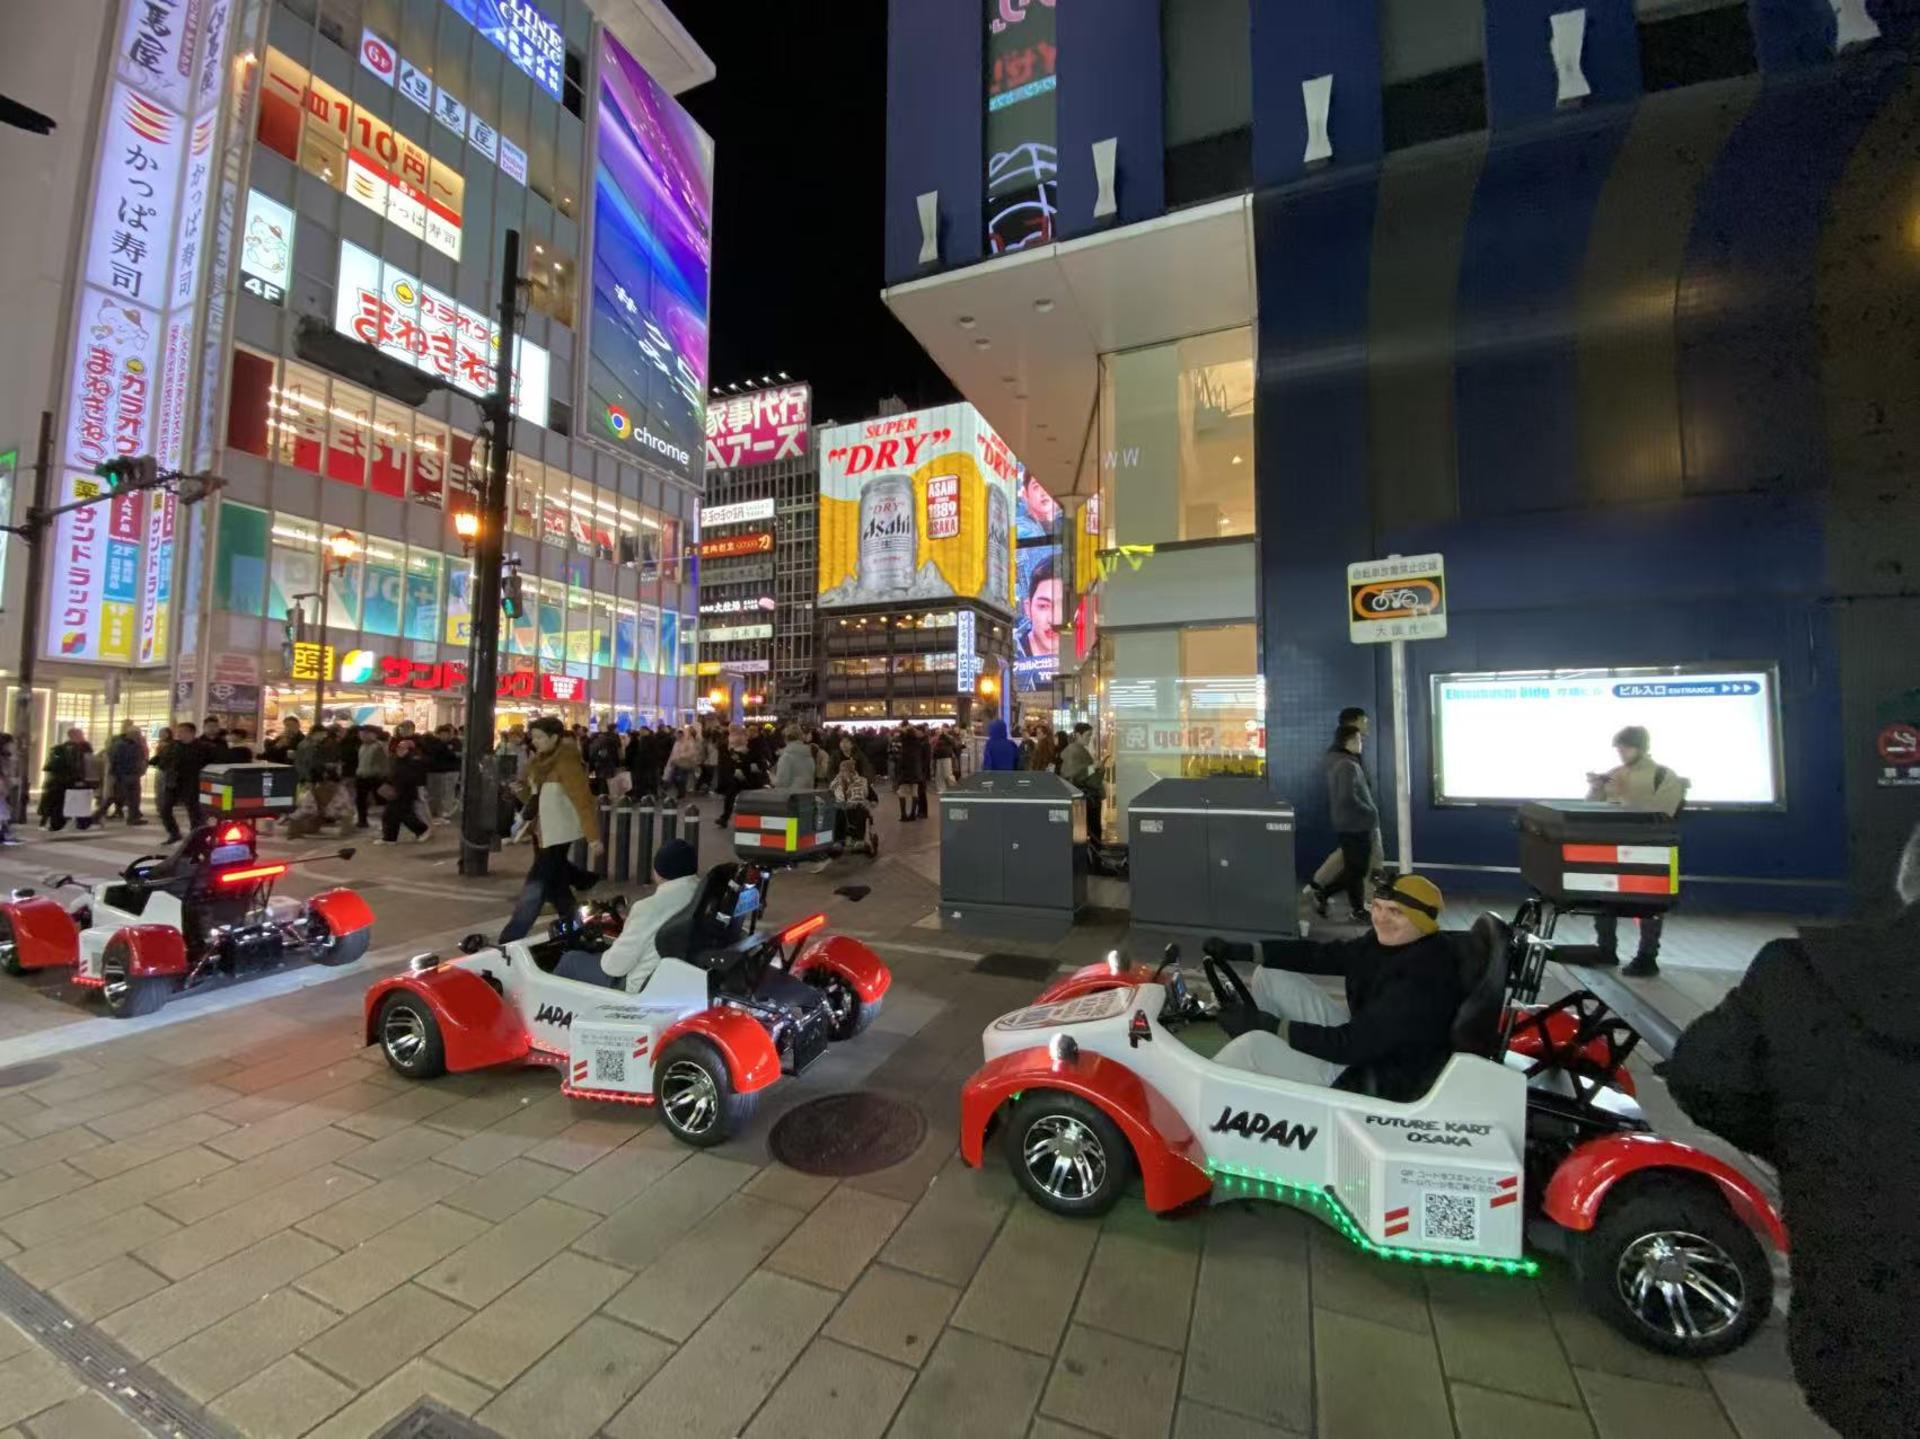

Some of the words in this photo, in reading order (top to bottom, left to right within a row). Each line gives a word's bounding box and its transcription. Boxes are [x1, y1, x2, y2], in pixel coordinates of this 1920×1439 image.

[111, 143, 159, 298] かっぱ寿司
[243, 276, 282, 301] 4F
[420, 292, 490, 342] カラオケ
[353, 290, 519, 405] まねきね
[115, 372, 147, 456] カラオケ
[863, 416, 918, 440] SUPER
[633, 426, 690, 466] chrome
[704, 422, 808, 470] ベアーズ
[928, 480, 957, 497] ASAHI
[863, 513, 910, 541] Asahi
[293, 645, 333, 680] 薬
[380, 655, 535, 698] サンドッグ
[1619, 684, 1667, 697] ビル入口
[1668, 686, 1716, 695] ENTRANCE
[534, 1002, 579, 1031] JAPA
[1209, 1104, 1319, 1151] JAPAN
[1365, 1115, 1441, 1132] FUTURE
[1444, 1121, 1495, 1137] KART
[1406, 1131, 1472, 1148] OSAKA
